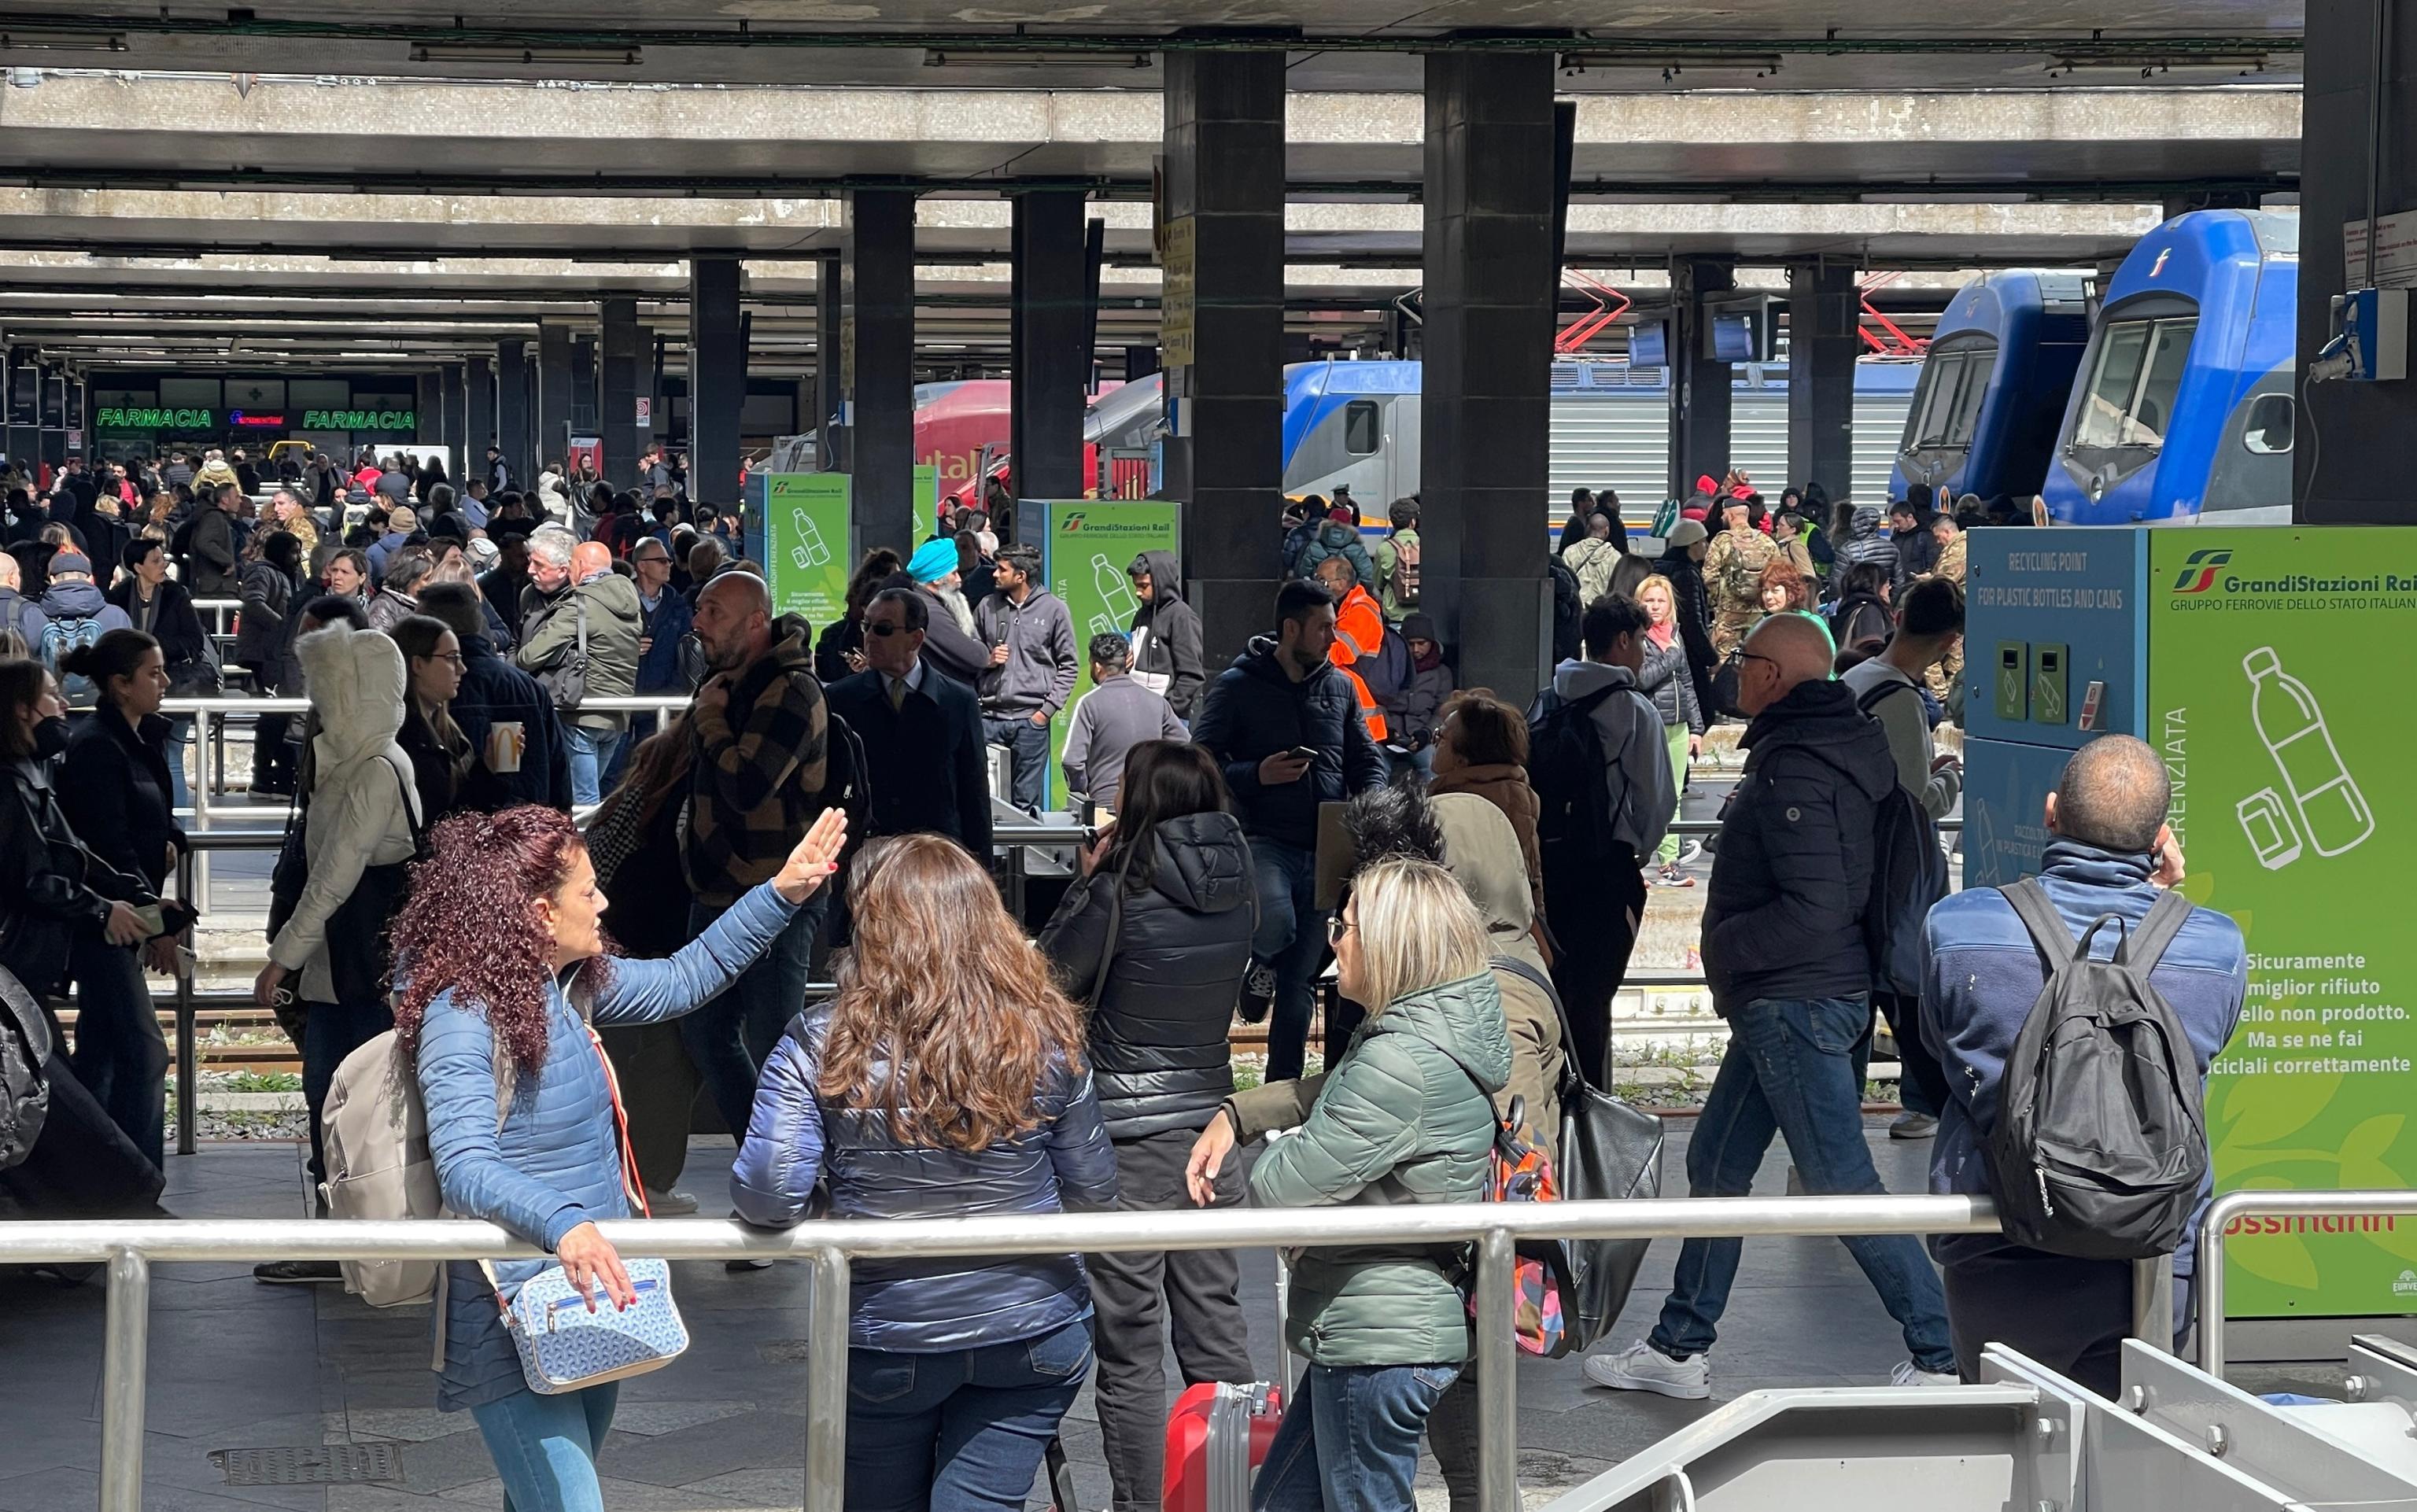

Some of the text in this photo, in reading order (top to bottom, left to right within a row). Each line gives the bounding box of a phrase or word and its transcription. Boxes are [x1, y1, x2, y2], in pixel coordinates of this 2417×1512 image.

[97, 408, 211, 427] FARMACIA
[303, 410, 415, 429] FARMACIA
[2009, 552, 2087, 571] RECYCLING POINT
[2224, 575, 2378, 592] GrandiStazioni
[1978, 588, 2122, 609] FOR PLASTIC BOTTLES AND CANS
[2171, 599, 2222, 610] GRUPPO
[2226, 599, 2282, 610] FERROVIE
[2286, 598, 2326, 610] DELLO
[2330, 598, 2367, 610] STATO
[2246, 953, 2365, 969] Sicuramente
[2248, 978, 2380, 1000] miglior rifiuto
[2241, 1004, 2410, 1024] ello non prodotto.
[2248, 1030, 2363, 1047] Ma se ne fai
[2273, 1057, 2411, 1074] correttamente
